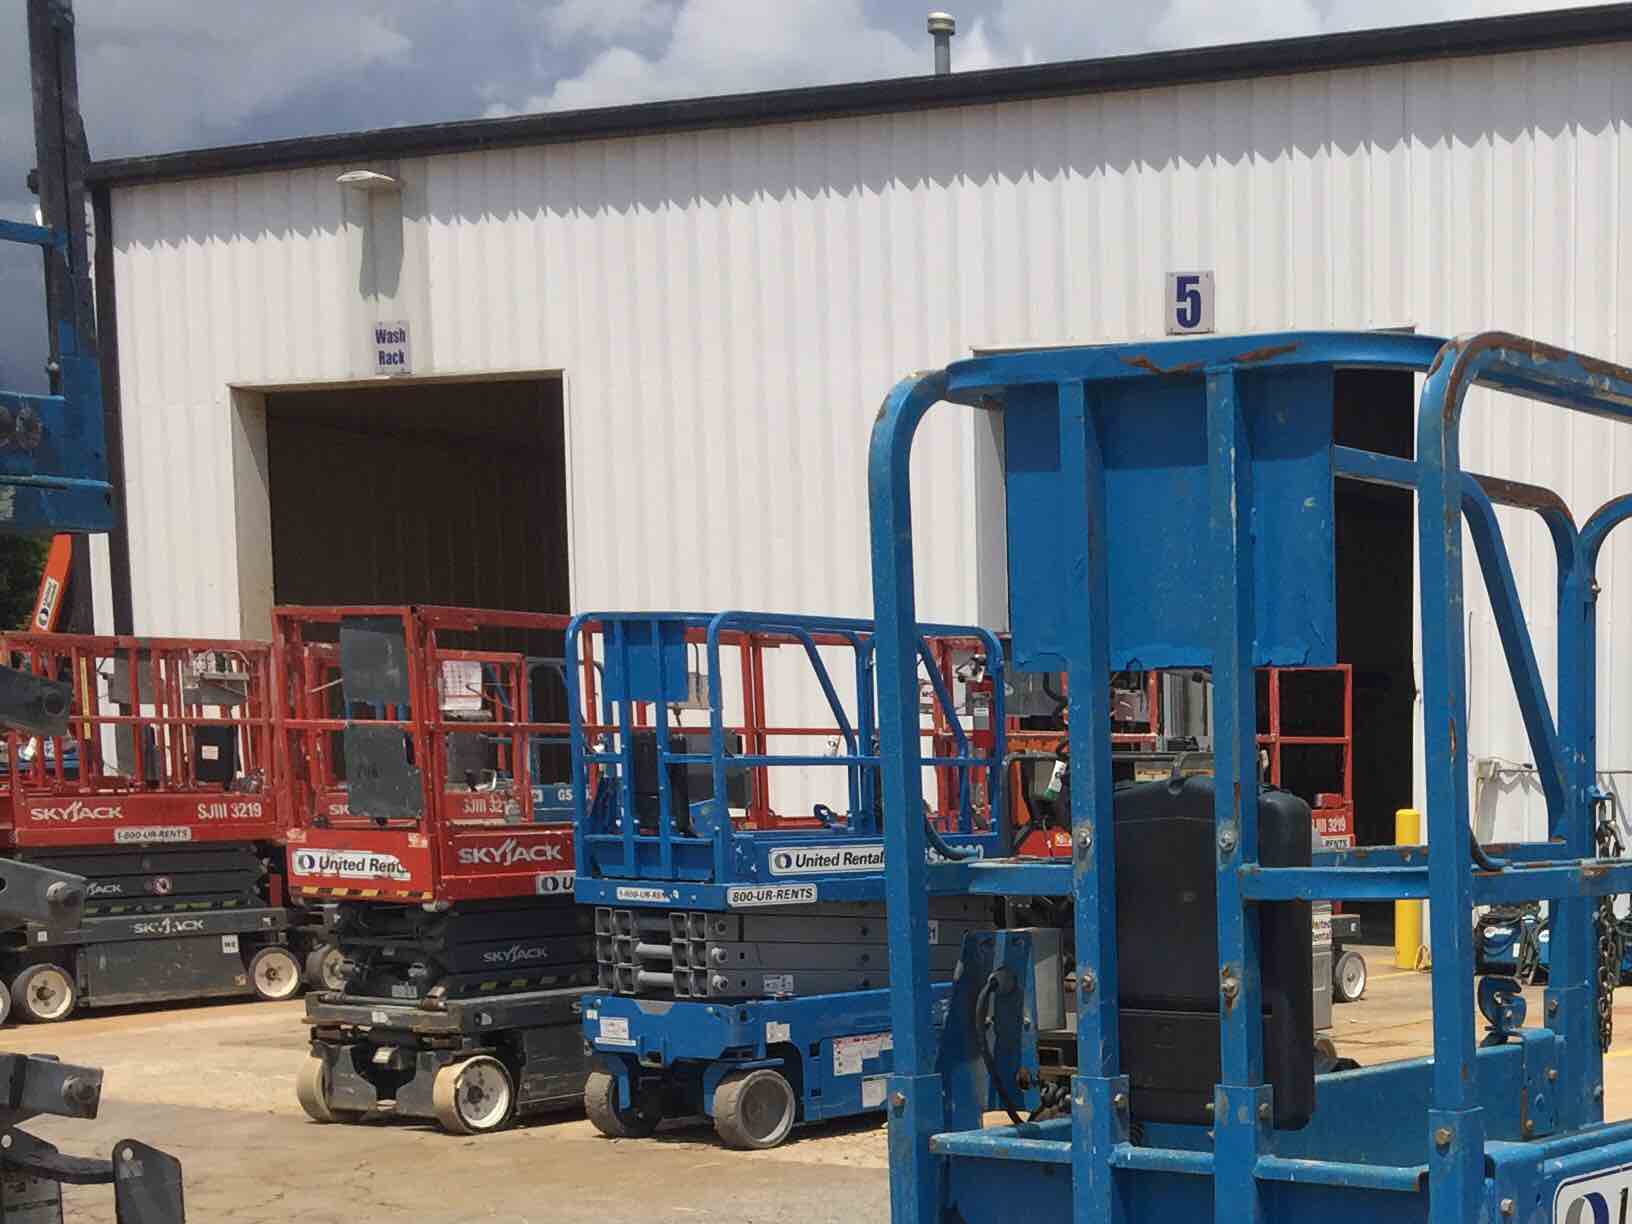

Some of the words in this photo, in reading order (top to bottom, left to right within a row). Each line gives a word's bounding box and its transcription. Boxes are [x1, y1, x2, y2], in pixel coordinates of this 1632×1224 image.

[1176, 275, 1202, 329] 5
[375, 327, 406, 344] Wash
[378, 349, 405, 366] Rack
[31, 800, 124, 822] SKYJACK
[230, 801, 262, 818] 3219
[458, 838, 563, 866] SKYJACK
[795, 852, 840, 869] United
[843, 851, 884, 867] Rental
[319, 855, 365, 872] United
